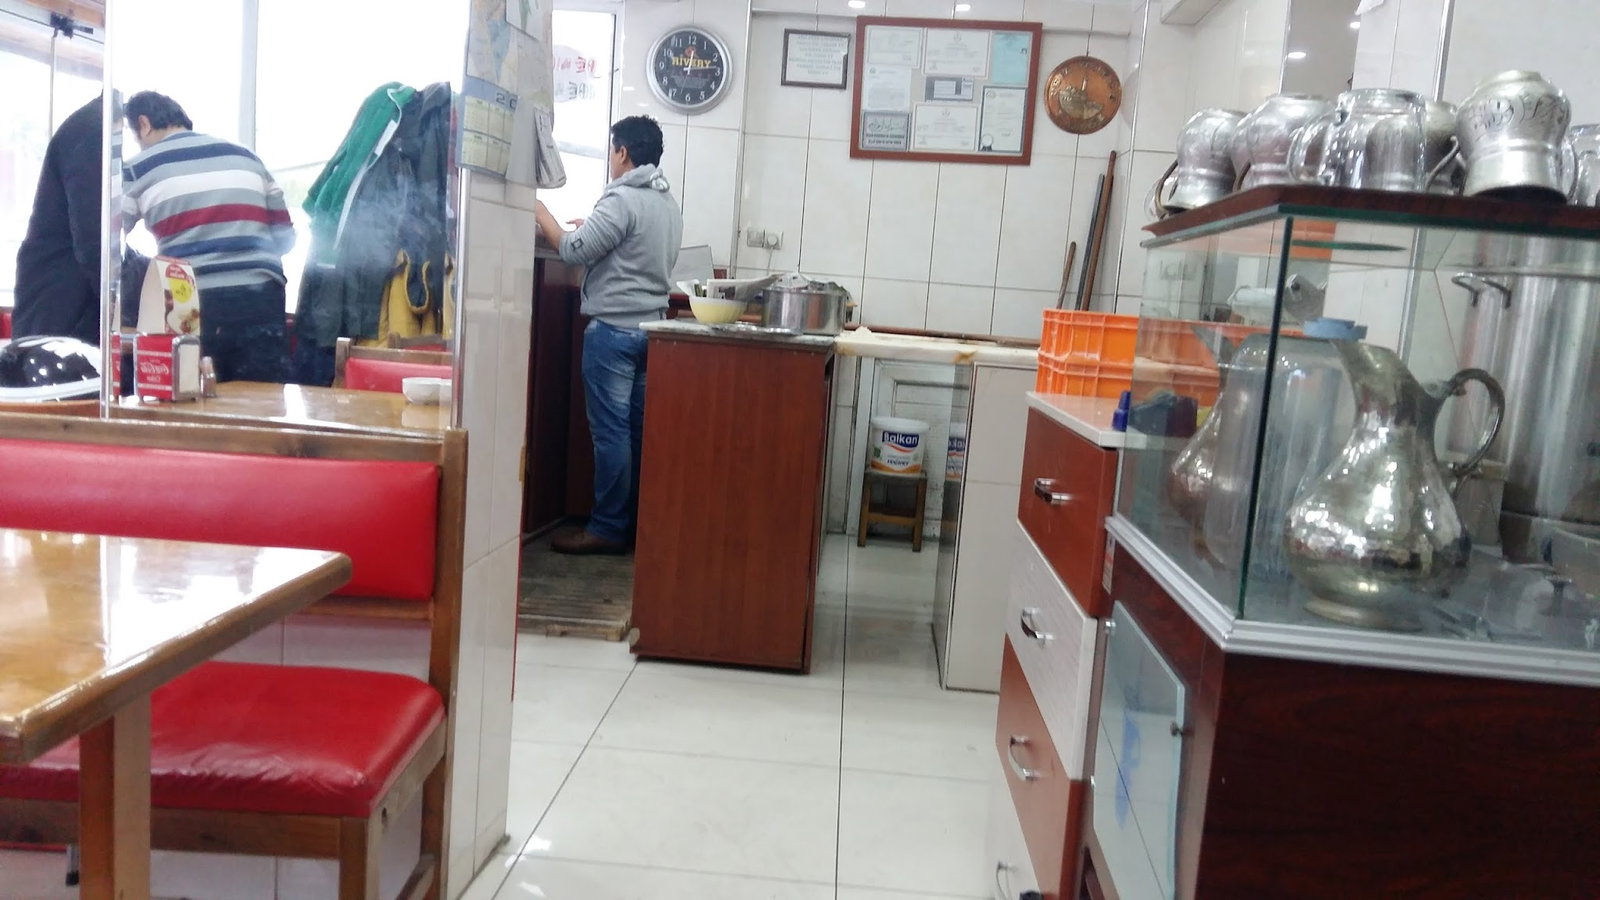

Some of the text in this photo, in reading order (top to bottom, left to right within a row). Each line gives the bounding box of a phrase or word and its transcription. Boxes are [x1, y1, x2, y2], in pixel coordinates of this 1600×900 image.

[688, 35, 697, 45] 12
[663, 48, 672, 58] 10
[712, 53, 718, 62] 2
[659, 61, 665, 70] 9
[715, 67, 720, 76] 3
[662, 76, 668, 86] 8
[710, 80, 716, 90] 4
[685, 92, 691, 102] 6
[700, 91, 705, 101] 5
[883, 432, 918, 445] Balkan
